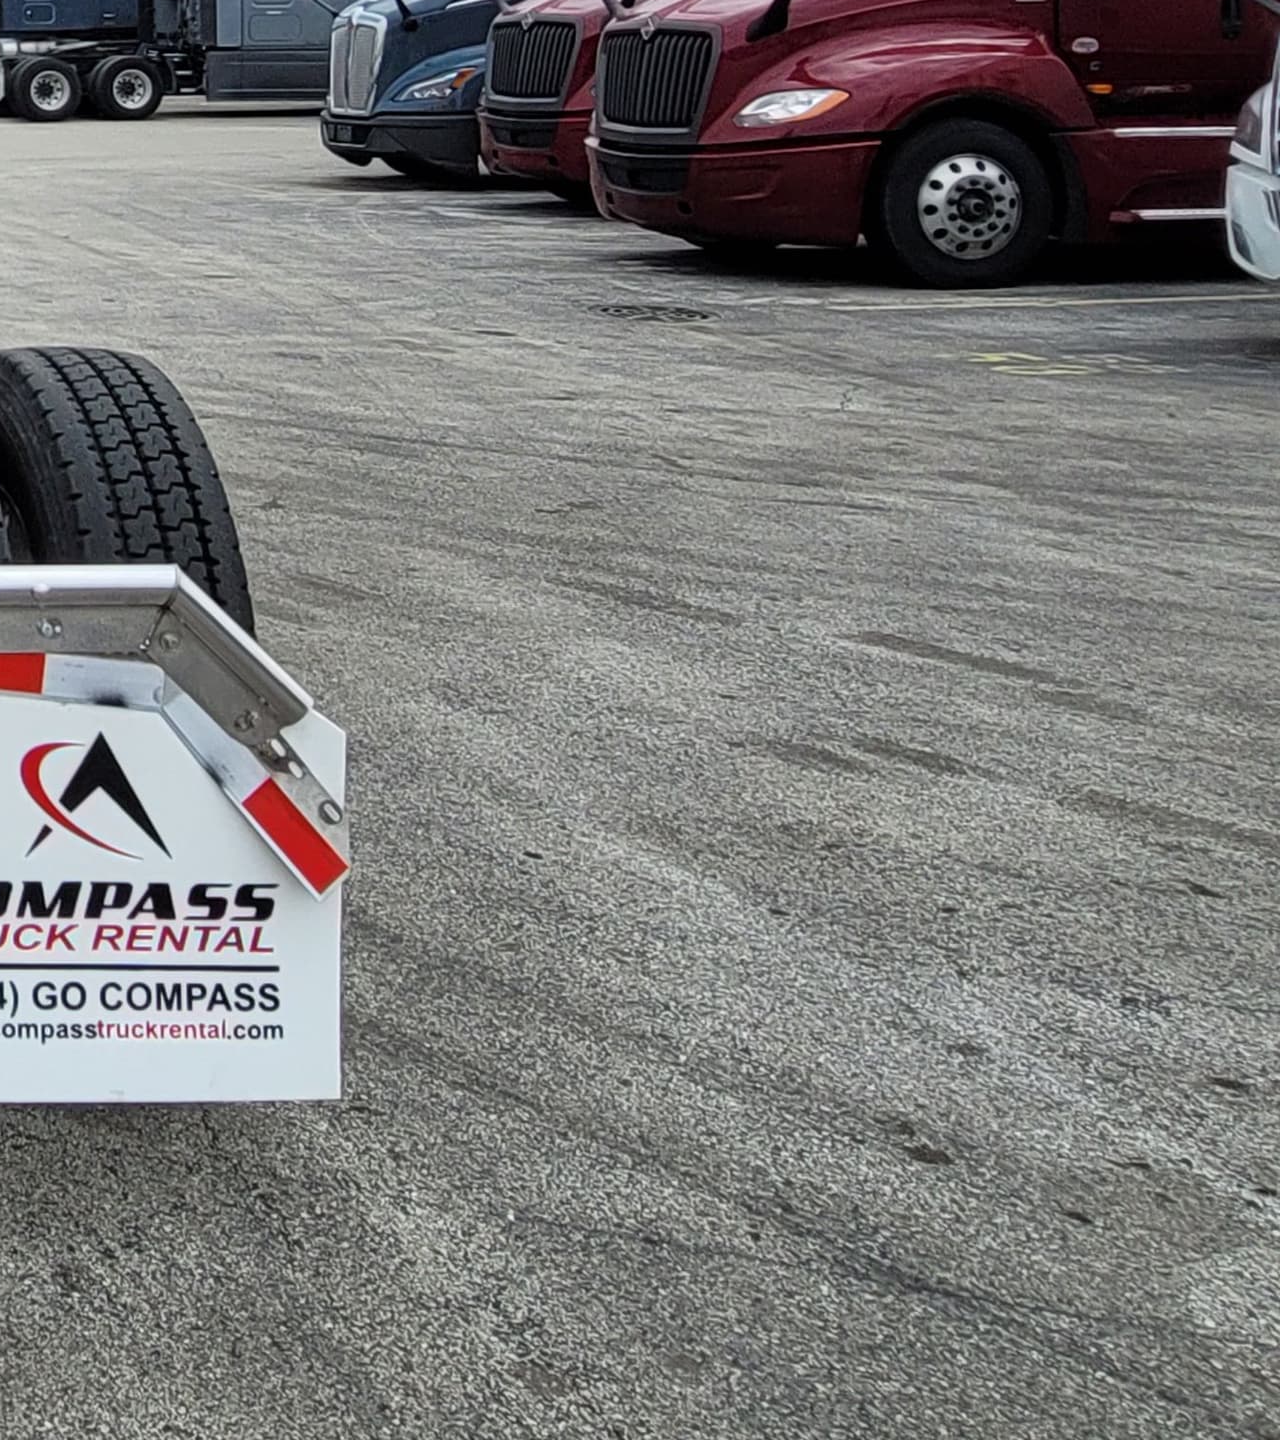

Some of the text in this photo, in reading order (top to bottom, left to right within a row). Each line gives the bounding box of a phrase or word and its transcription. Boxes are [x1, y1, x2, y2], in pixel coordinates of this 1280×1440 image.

[92, 924, 274, 953] RENTAL
[32, 981, 87, 1011] GO
[99, 982, 281, 1012] COMPASS
